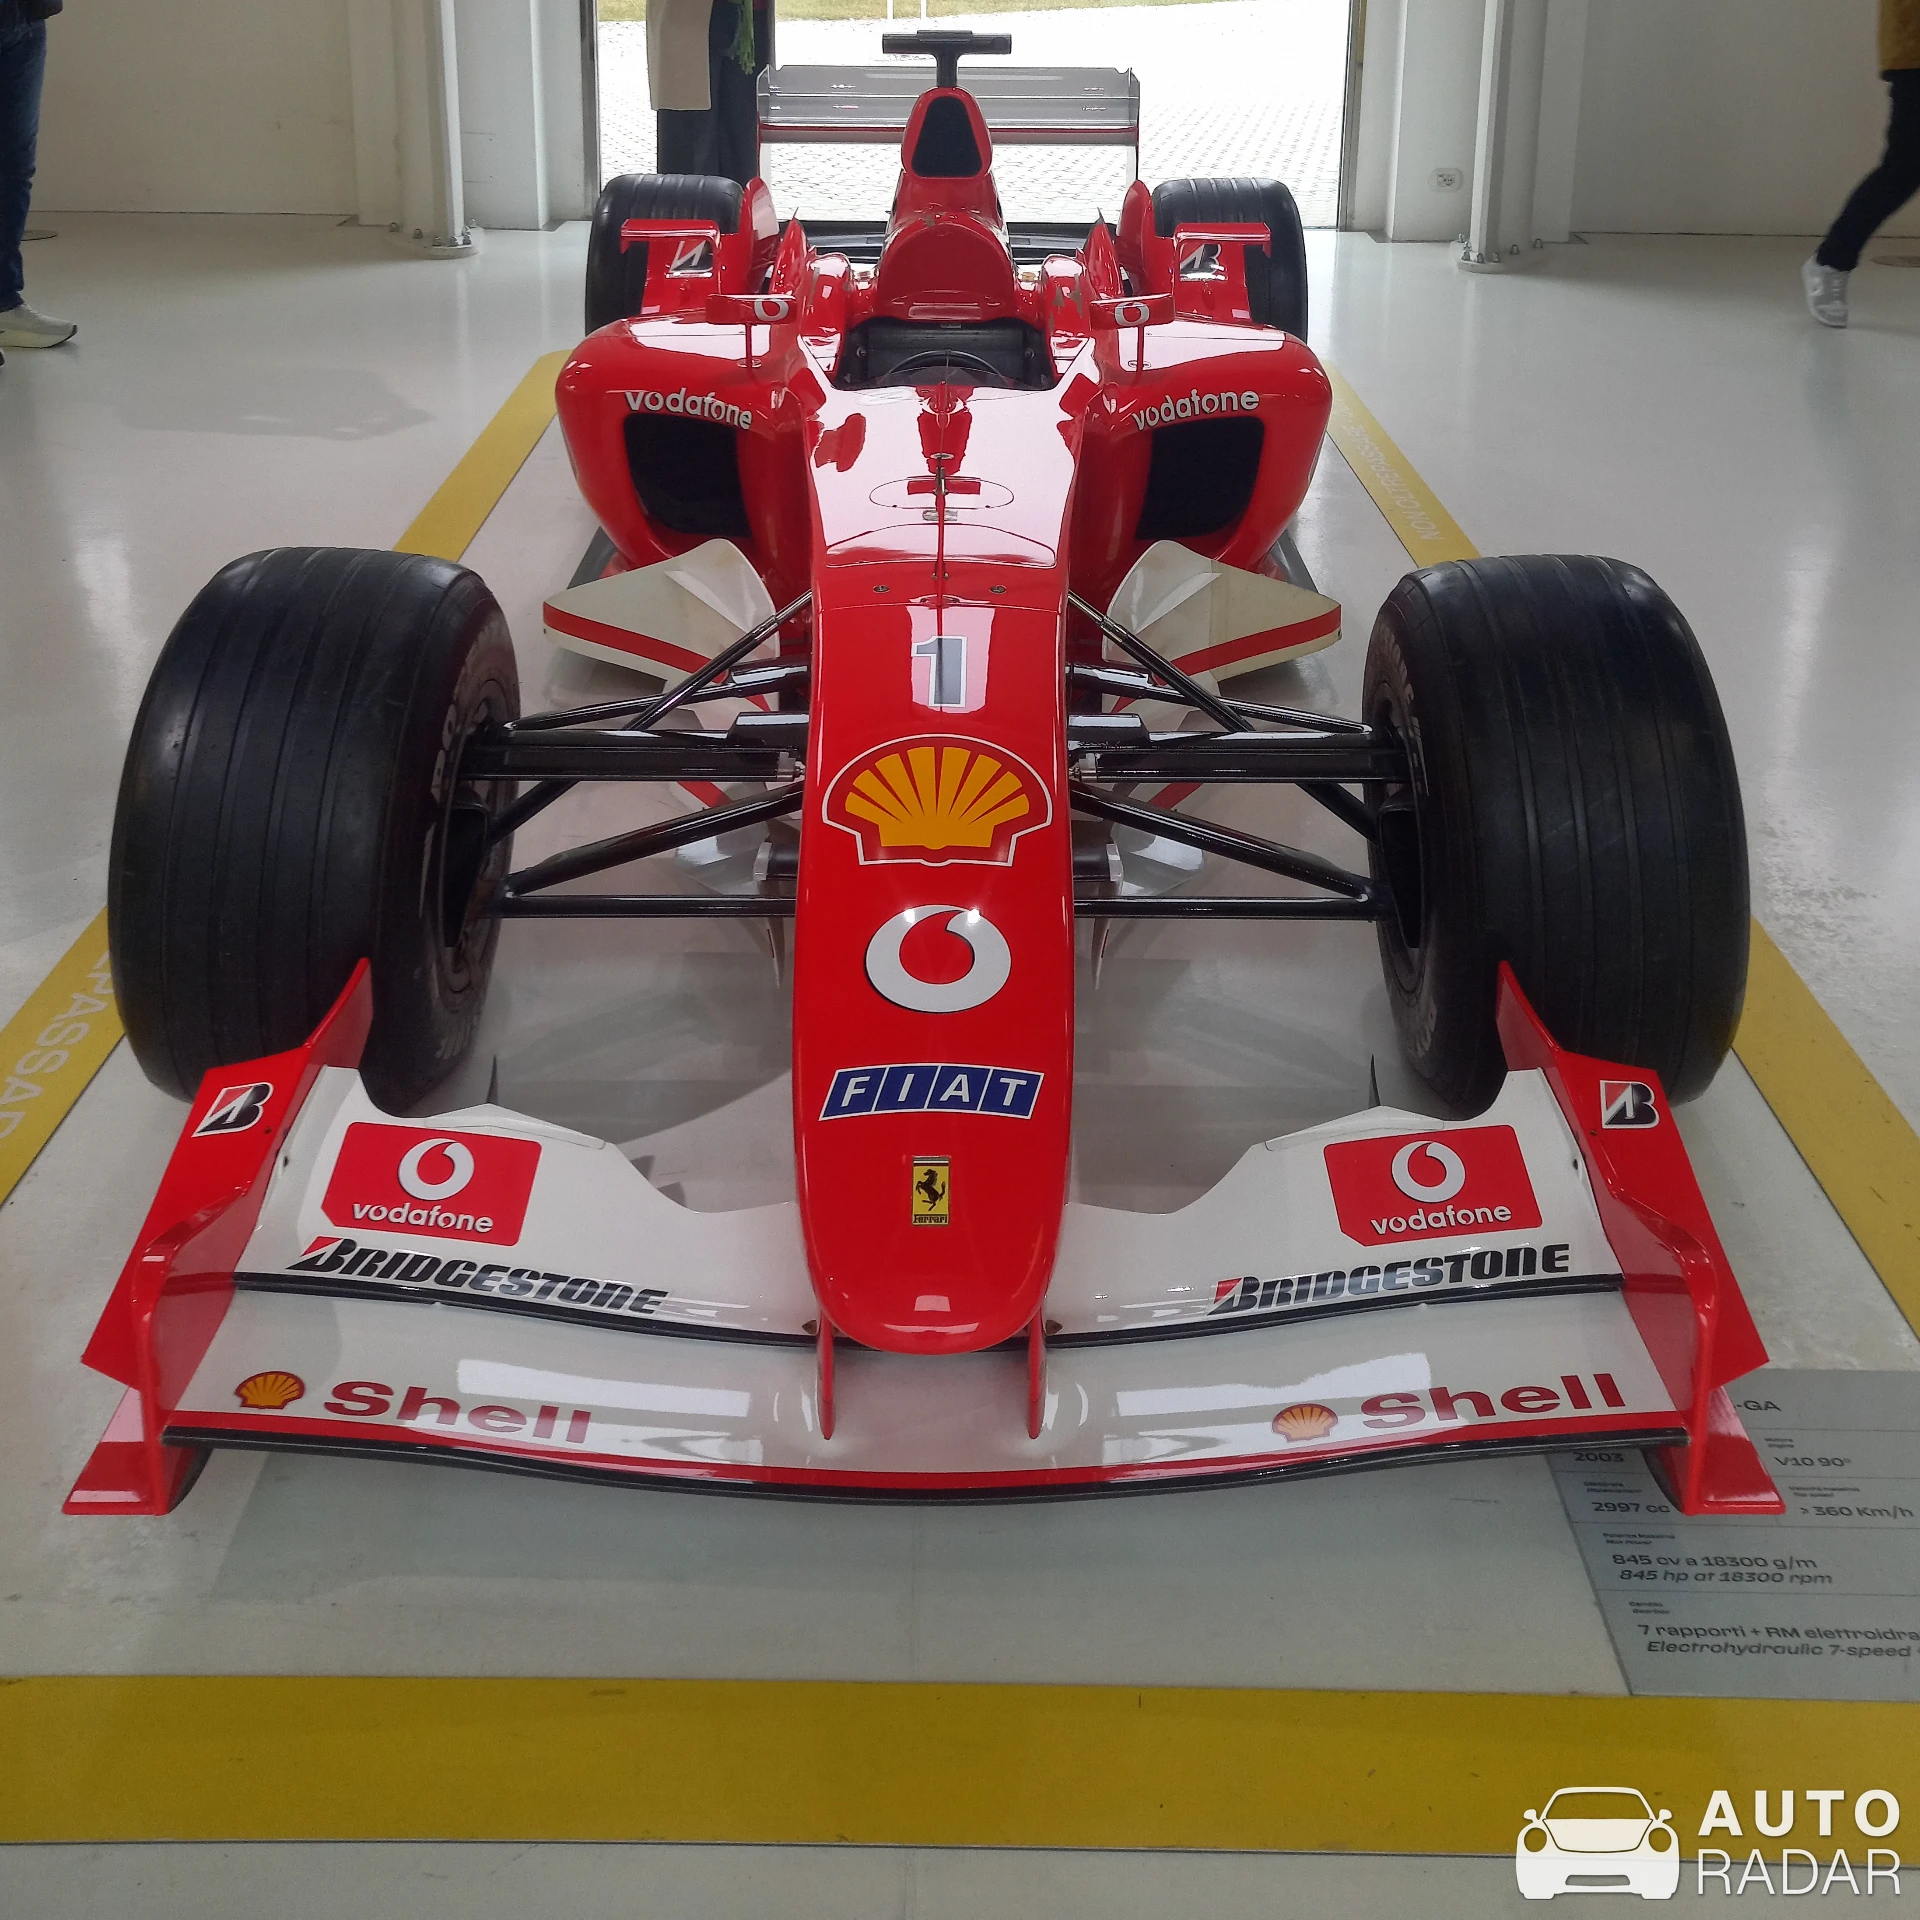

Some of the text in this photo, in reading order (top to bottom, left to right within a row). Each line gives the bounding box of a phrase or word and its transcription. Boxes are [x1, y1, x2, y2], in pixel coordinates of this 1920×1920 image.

[625, 387, 753, 430] vodafone
[1131, 388, 1260, 431] vodafone
[910, 635, 967, 708] 1
[840, 1073, 1028, 1108] FIAT
[352, 1202, 494, 1234] vodafone
[912, 1214, 948, 1225] Ferrari
[1370, 1204, 1512, 1236] vodafone
[285, 1236, 668, 1315] BRIDGESTONE
[1207, 1244, 1570, 1316] BRIDGESTONE
[323, 1381, 593, 1444] Shell
[1361, 1373, 1626, 1429] Shell
[1735, 1400, 1782, 1412] -GA
[1573, 1452, 1625, 1463] 2003
[1774, 1456, 1814, 1467] V10
[1592, 1502, 1671, 1513] 2997 cc
[1812, 1506, 1854, 1517] 360
[1612, 1554, 1818, 1570] 845 cv a 18300 g/m
[1619, 1569, 1833, 1585] 845 hp at 18300 rpm
[1637, 1624, 1650, 1636] 7
[1655, 1624, 1747, 1639] rapporti
[1764, 1626, 1801, 1639] RM
[1647, 1640, 1823, 1656] Electrohydraulic
[1828, 1643, 1913, 1658] 7-speed
